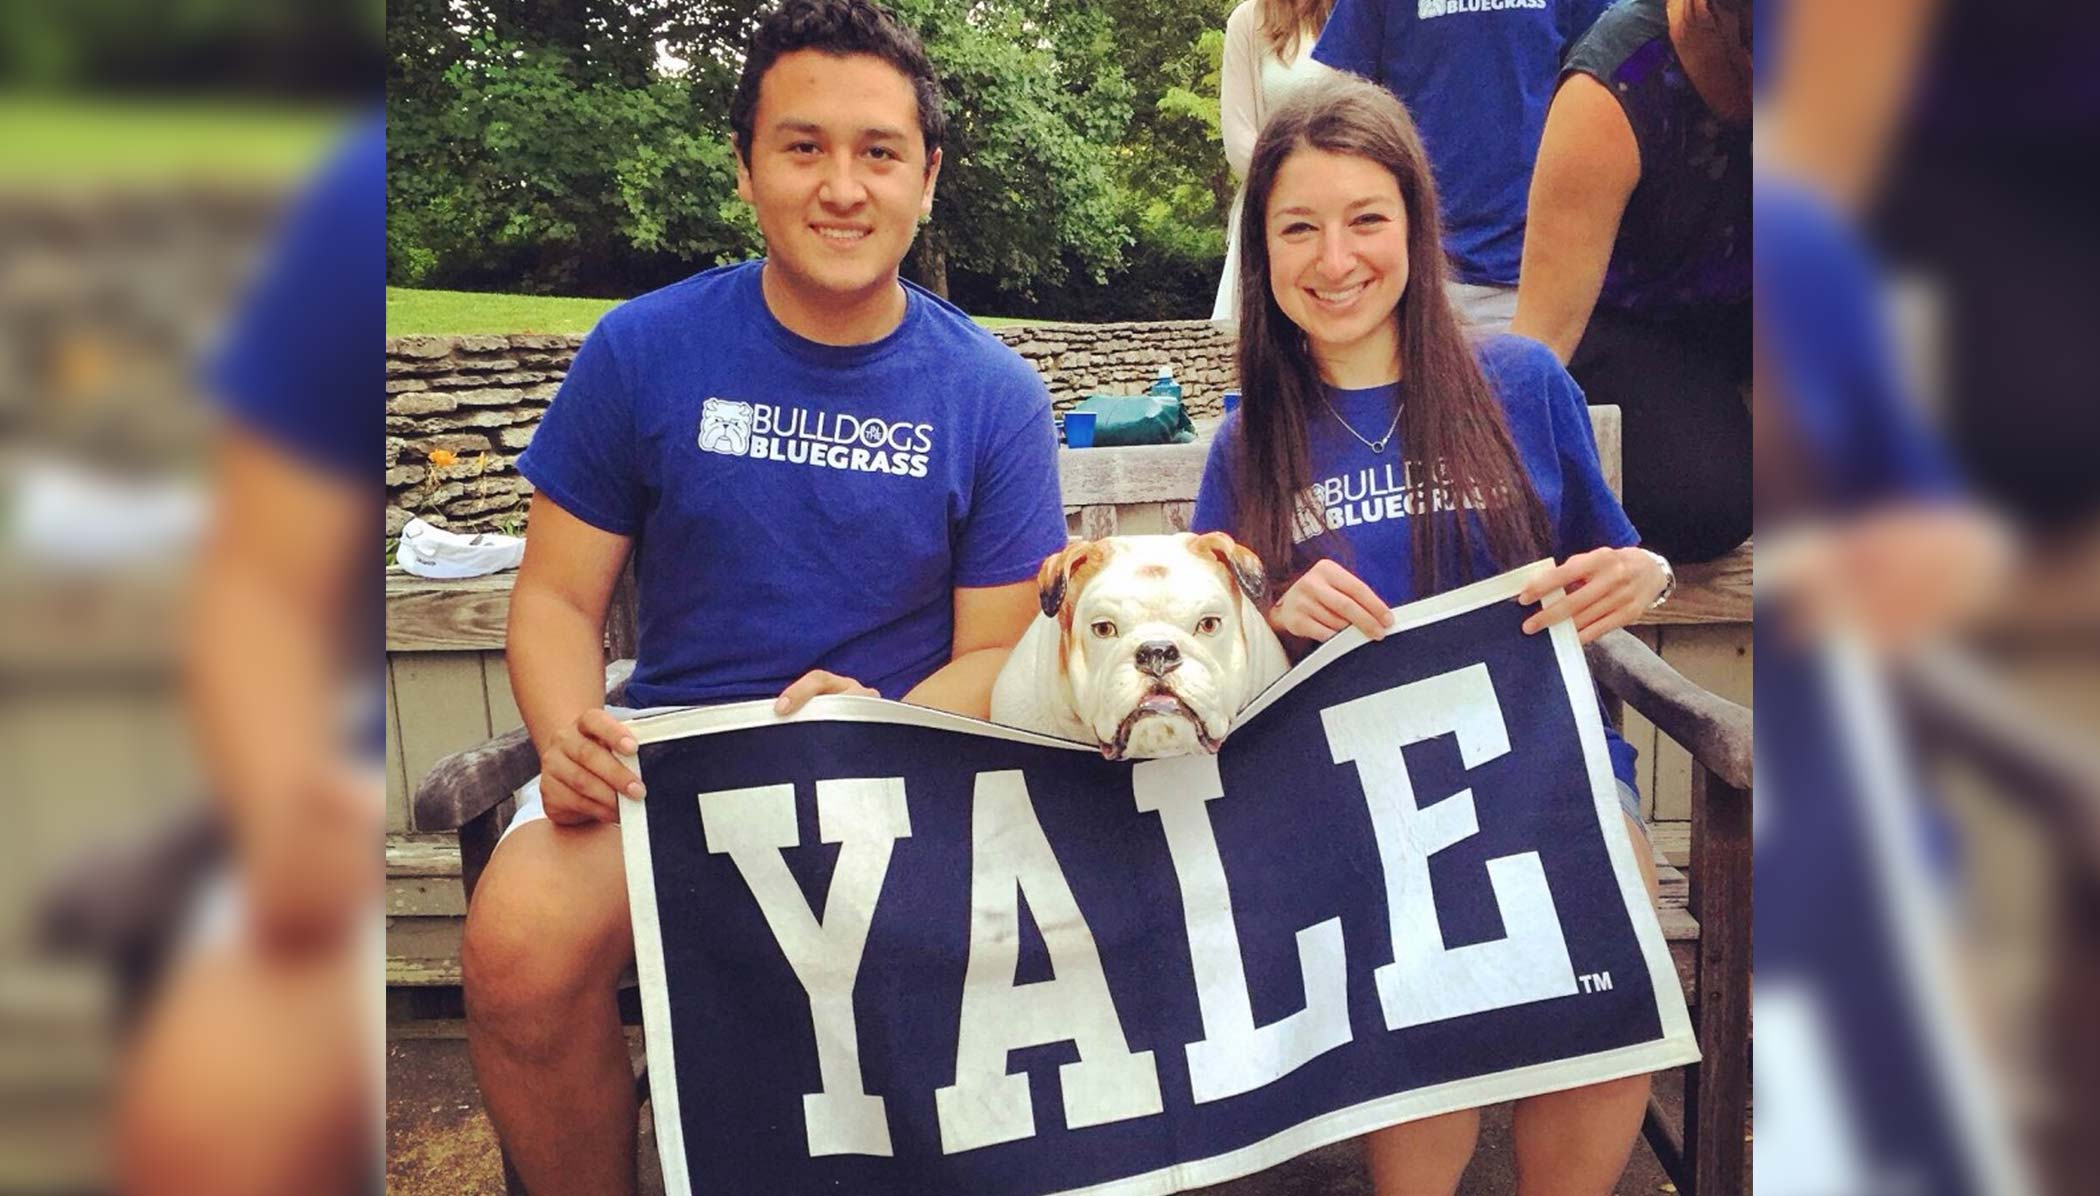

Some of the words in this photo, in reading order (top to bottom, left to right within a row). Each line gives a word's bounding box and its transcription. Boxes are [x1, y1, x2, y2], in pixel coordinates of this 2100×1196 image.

[1447, 0, 1547, 14] BLUEGRASS
[753, 403, 934, 453] BULLDOGS
[750, 436, 930, 478] BLUEGRASS
[697, 662, 1579, 1156] YALE
[1579, 971, 1613, 994] TM
